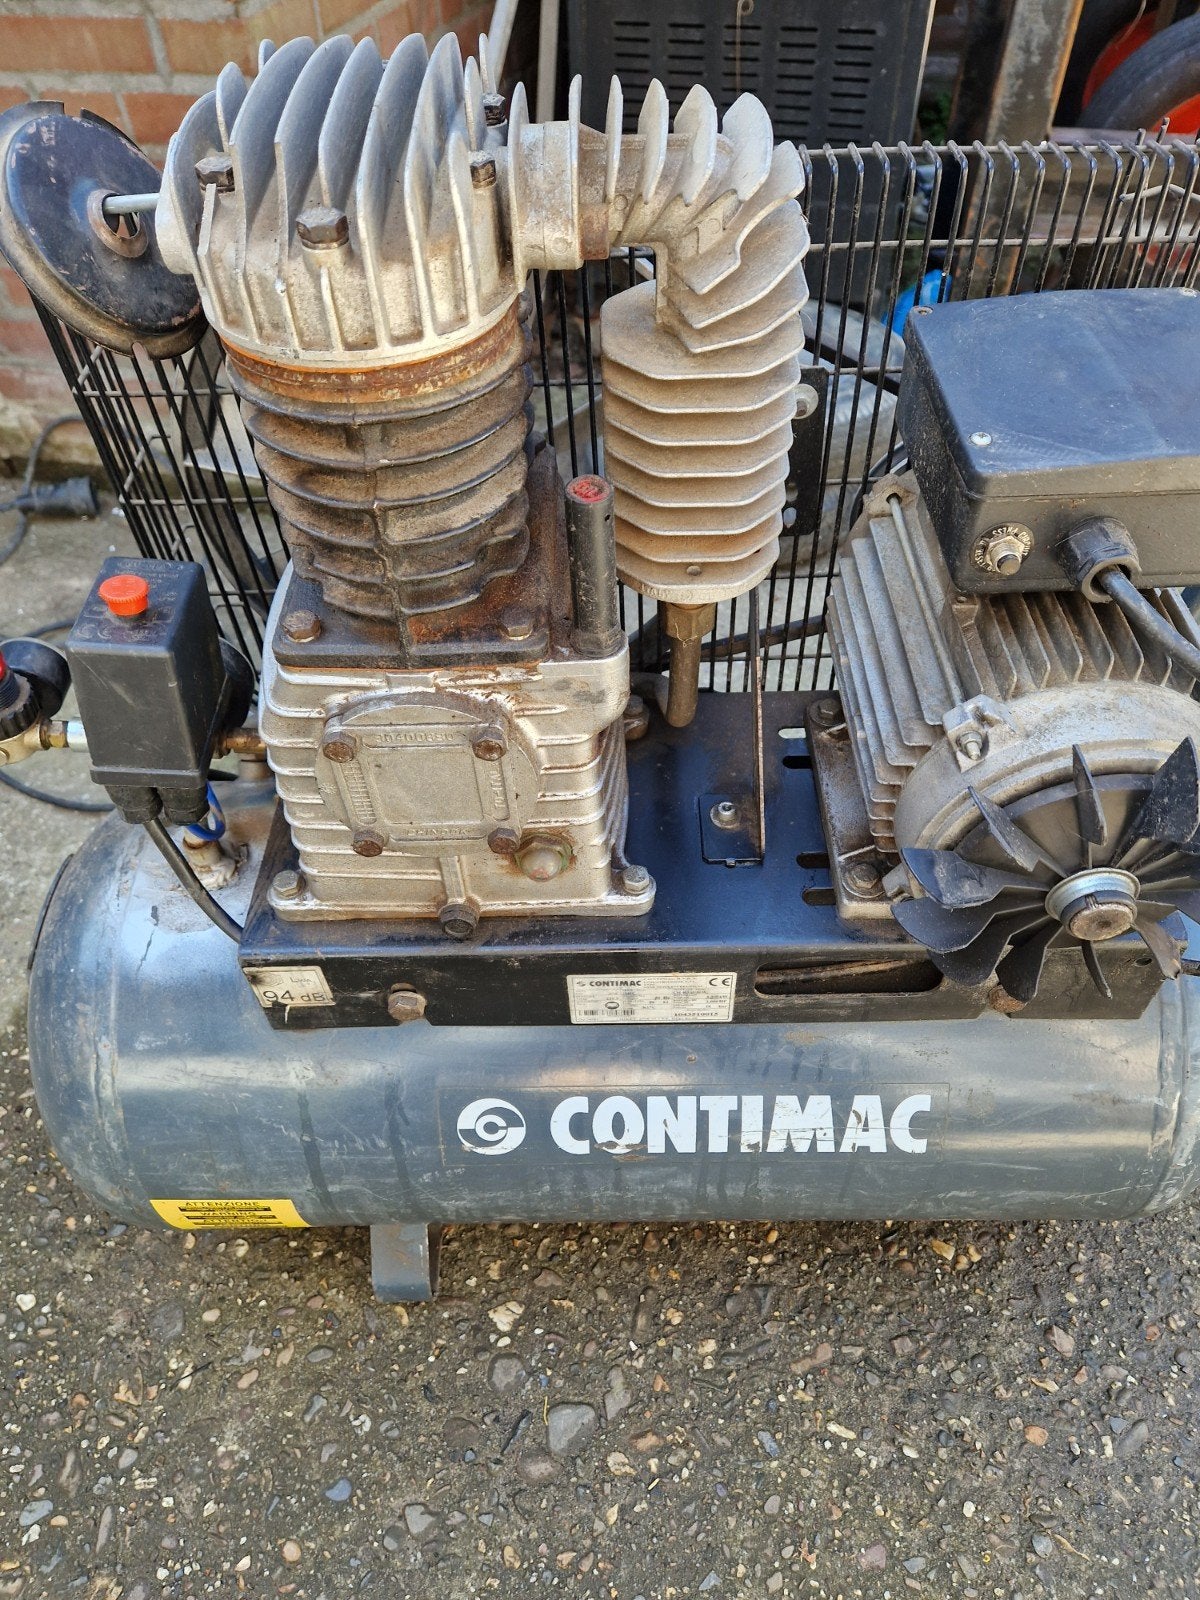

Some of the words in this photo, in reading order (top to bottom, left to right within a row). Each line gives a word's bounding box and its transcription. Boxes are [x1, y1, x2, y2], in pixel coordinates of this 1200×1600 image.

[708, 977, 731, 987] CE
[262, 989, 295, 1003] 94
[300, 992, 326, 1003] dB
[549, 1094, 932, 1156] CONTIMAC
